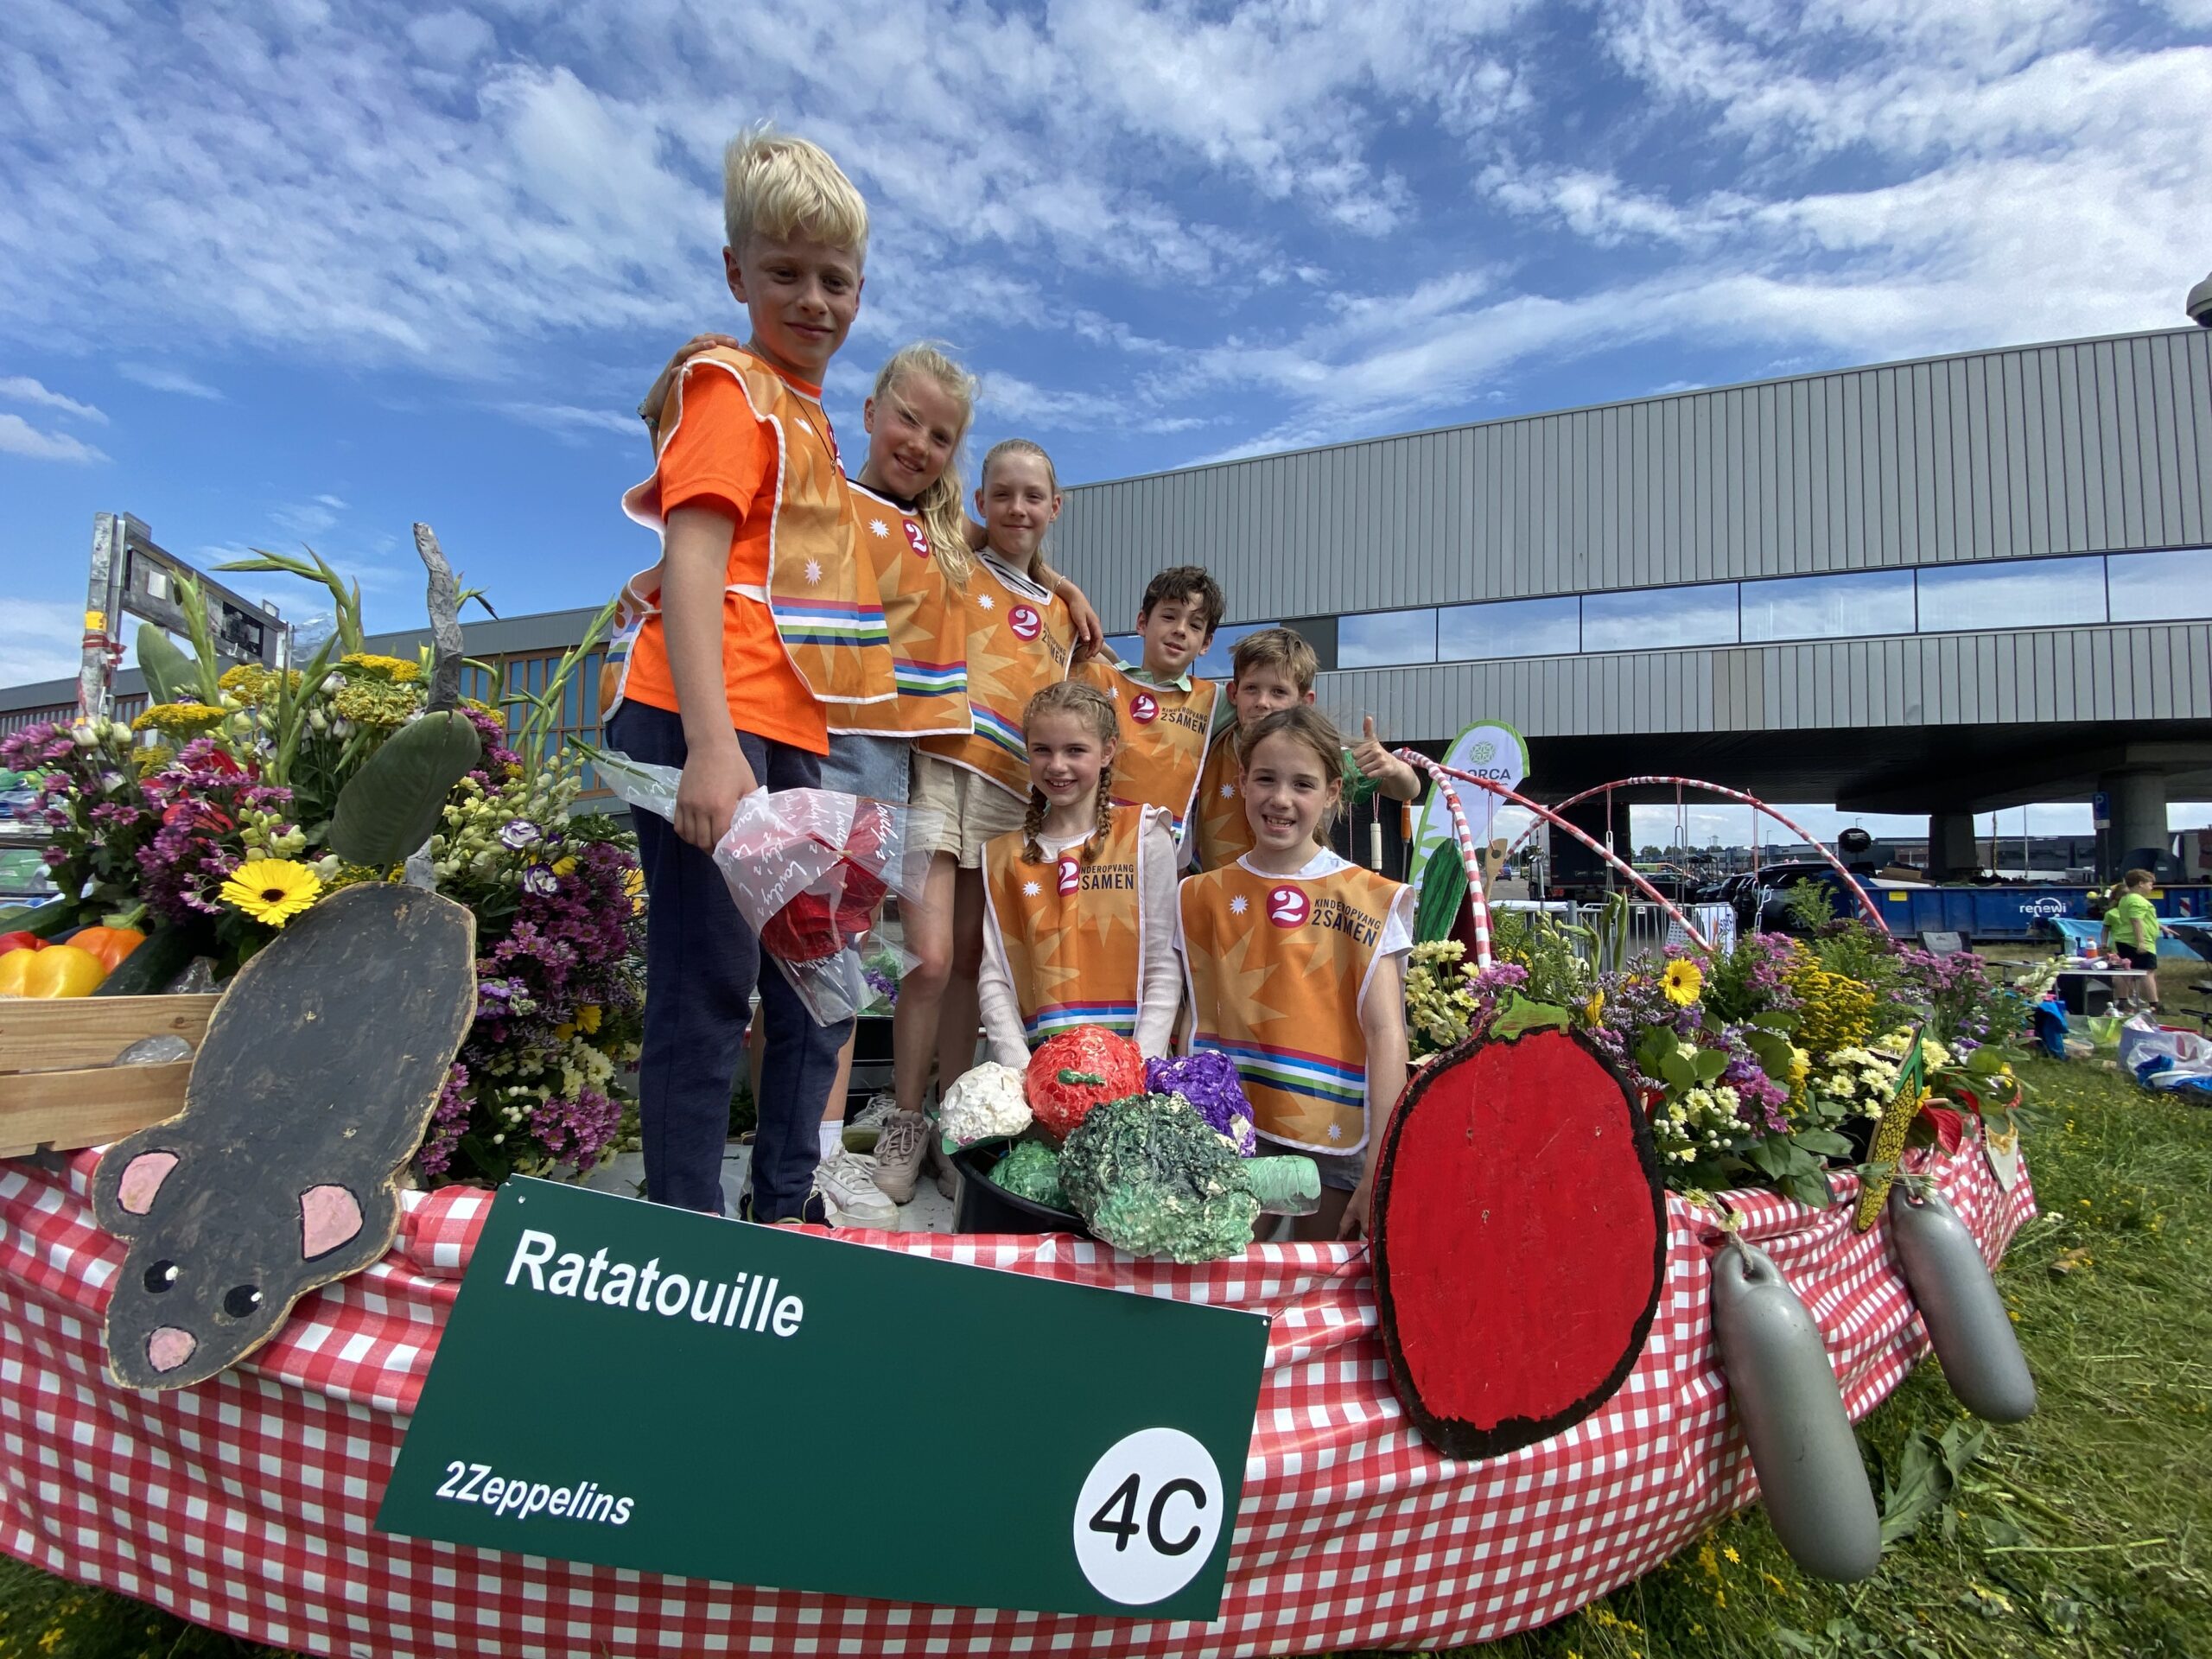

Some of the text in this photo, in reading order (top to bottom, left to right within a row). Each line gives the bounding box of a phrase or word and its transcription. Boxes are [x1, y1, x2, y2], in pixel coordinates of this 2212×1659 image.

[1012, 608, 1038, 637] 2
[1160, 712, 1207, 735] 2SAMEN
[1080, 864, 1134, 874] NDEROPVANG
[1081, 874, 1135, 891] SAMEN
[1272, 890, 1304, 923] 2
[2019, 900, 2067, 917] renewi
[1312, 908, 1377, 948] 2SAMEN
[505, 1229, 804, 1338] Ratatouille
[435, 1460, 635, 1525] 2Zeppelins
[1089, 1472, 1207, 1556] 4C
